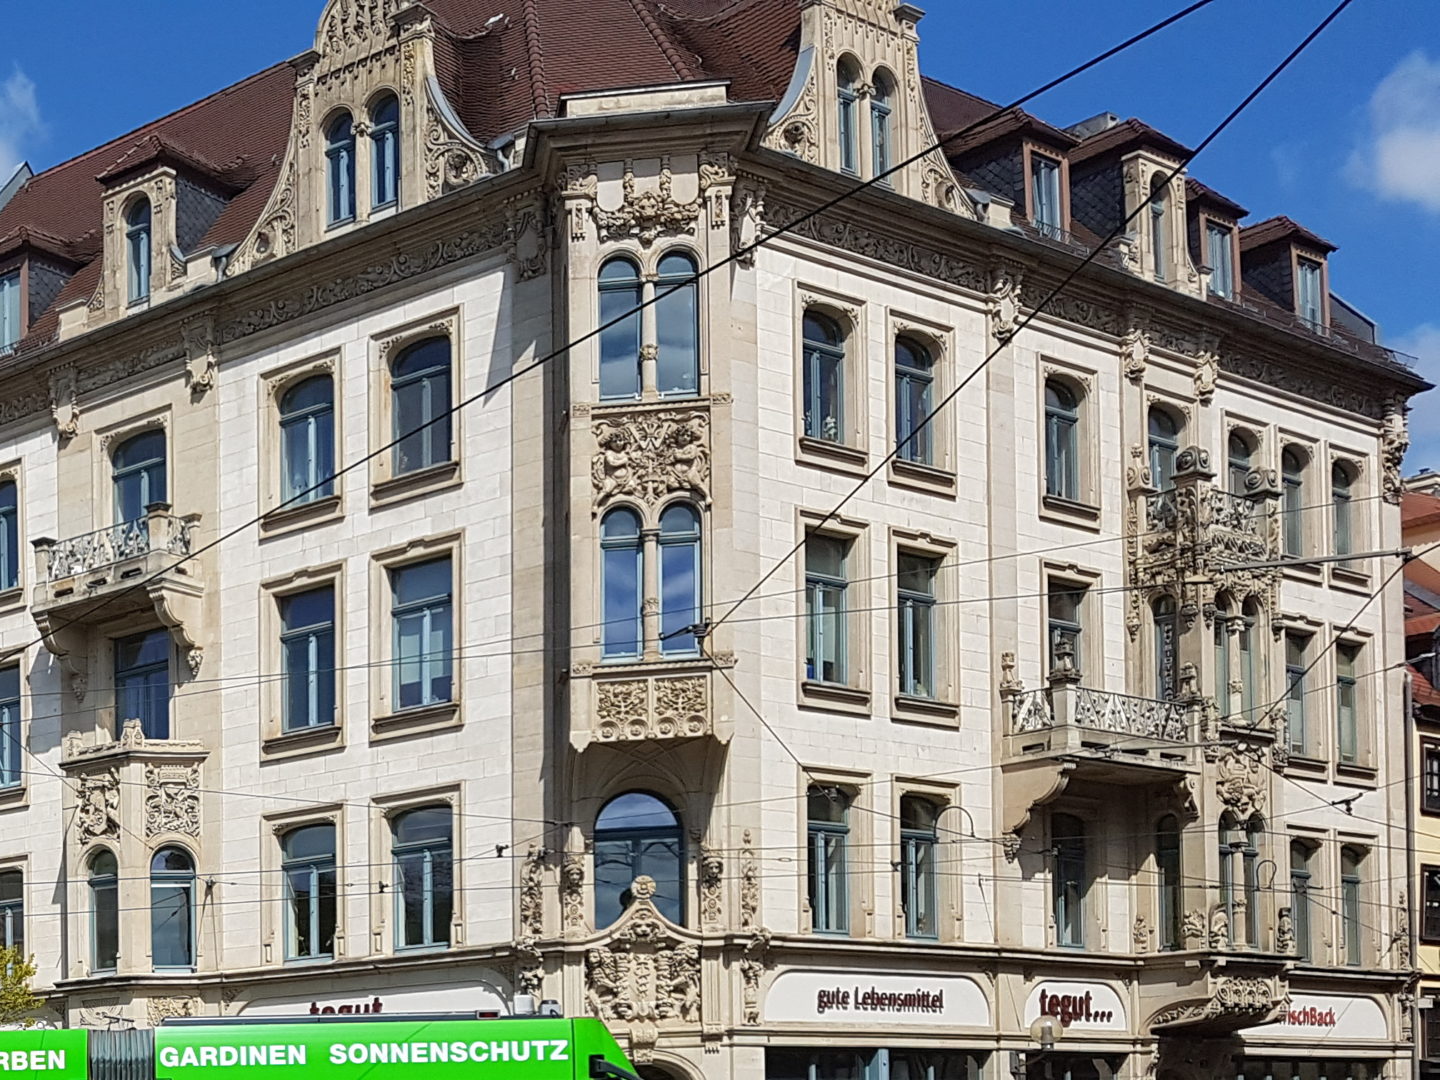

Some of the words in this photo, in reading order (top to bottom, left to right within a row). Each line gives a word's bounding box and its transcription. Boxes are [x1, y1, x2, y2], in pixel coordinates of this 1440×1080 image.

[817, 988, 850, 1012] gute
[854, 986, 944, 1012] Lebensmittel
[1288, 1006, 1336, 1027] ischBack
[159, 1044, 306, 1068] GARDINEN
[329, 1039, 569, 1064] SONNENSCHUTZ
